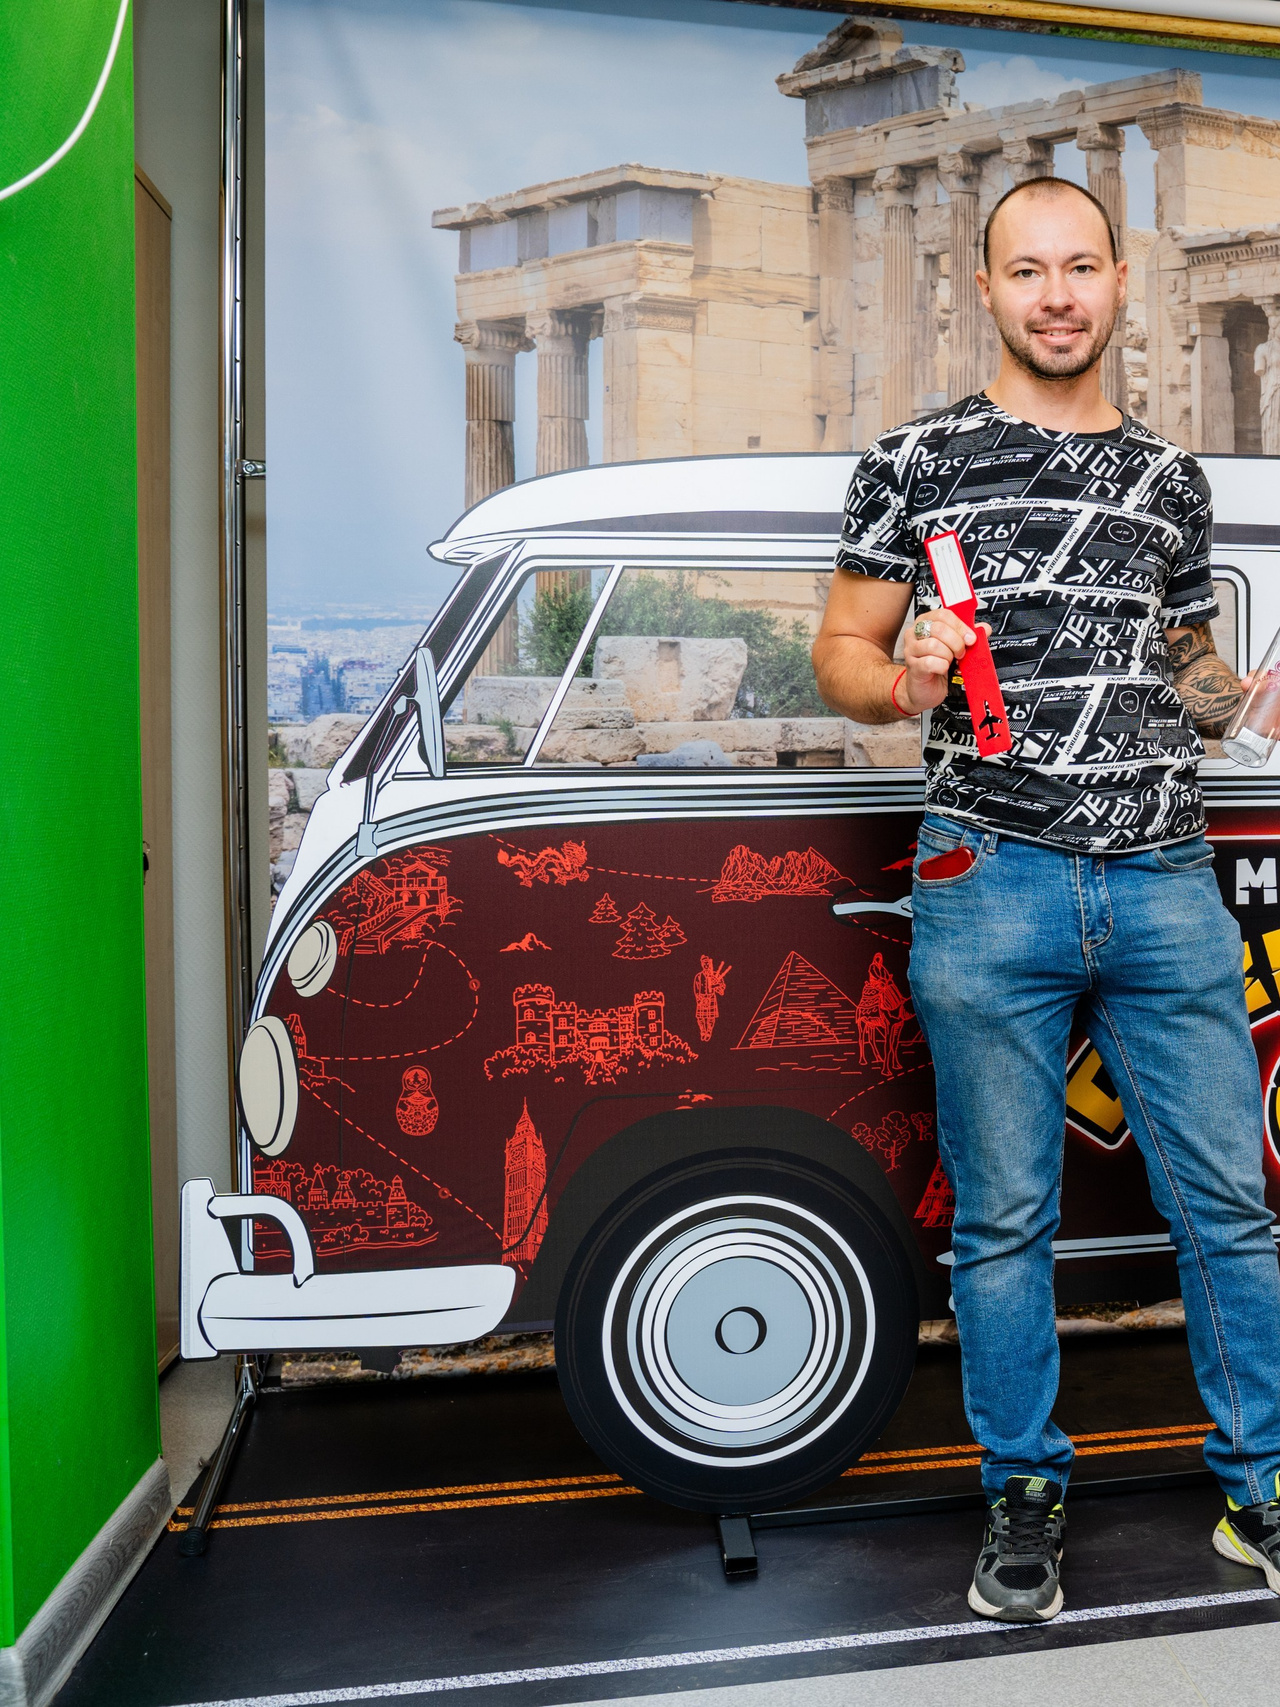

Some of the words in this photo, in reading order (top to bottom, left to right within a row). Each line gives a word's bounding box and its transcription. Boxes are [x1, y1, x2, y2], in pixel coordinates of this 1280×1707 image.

[973, 456, 997, 464] ENJOY
[992, 458, 1031, 466] DIFFIRENT
[1097, 505, 1118, 513] ENJOY
[1133, 512, 1164, 524] DIFFIRENT
[1022, 679, 1060, 688] DIFFIRENT
